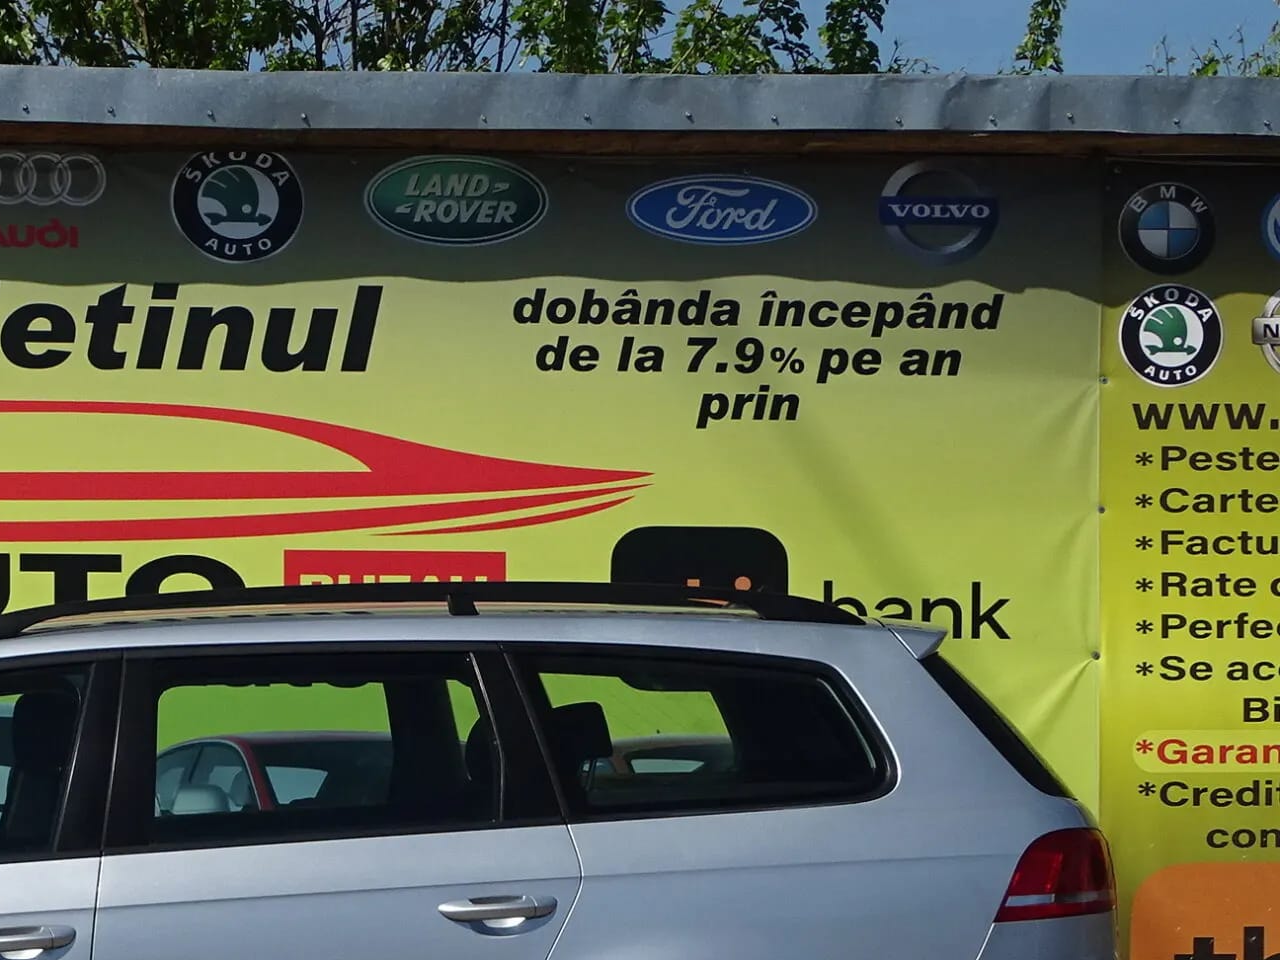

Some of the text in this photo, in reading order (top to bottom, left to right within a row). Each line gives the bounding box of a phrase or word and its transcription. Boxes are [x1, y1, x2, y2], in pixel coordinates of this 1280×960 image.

[664, 184, 779, 232] Ford
[887, 202, 991, 220] VOLVO
[1129, 185, 1208, 214] BMW
[203, 236, 273, 256] AUTO
[513, 288, 1005, 337] dobânda începând
[535, 335, 962, 384] de la 7.9% pe an
[1144, 364, 1197, 381] AUTO
[696, 384, 800, 429] prin
[1132, 403, 1279, 430] www.
[1135, 612, 1280, 639] Perfe
[1226, 661, 1280, 681] ac
[1137, 779, 1280, 808] Credi
